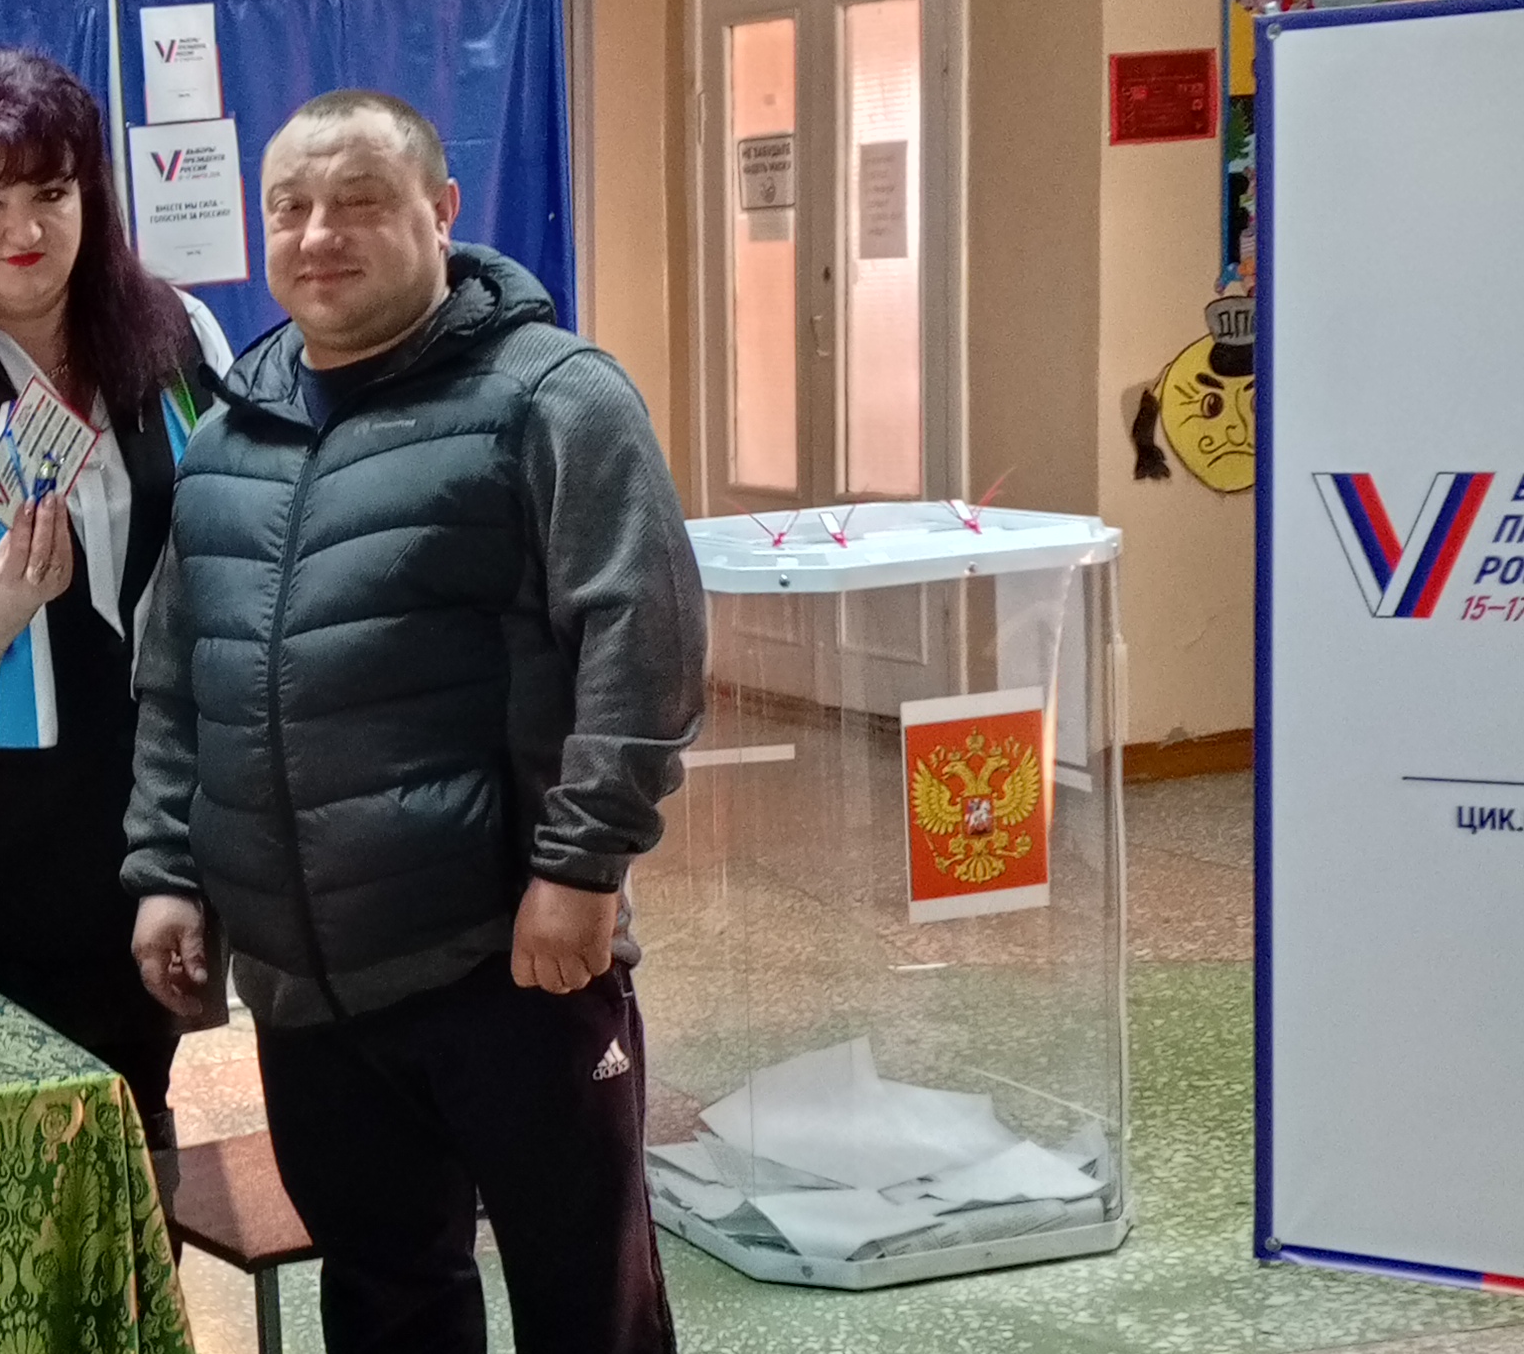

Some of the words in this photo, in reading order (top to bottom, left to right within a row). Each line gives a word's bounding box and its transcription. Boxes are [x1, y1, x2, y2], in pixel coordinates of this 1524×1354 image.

[156, 203, 182, 213] ВМЕСТЕ
[185, 202, 197, 210] МЫ
[1492, 514, 1524, 543] П
[1473, 556, 1524, 585] РО
[1456, 806, 1524, 835] ЦИК.
